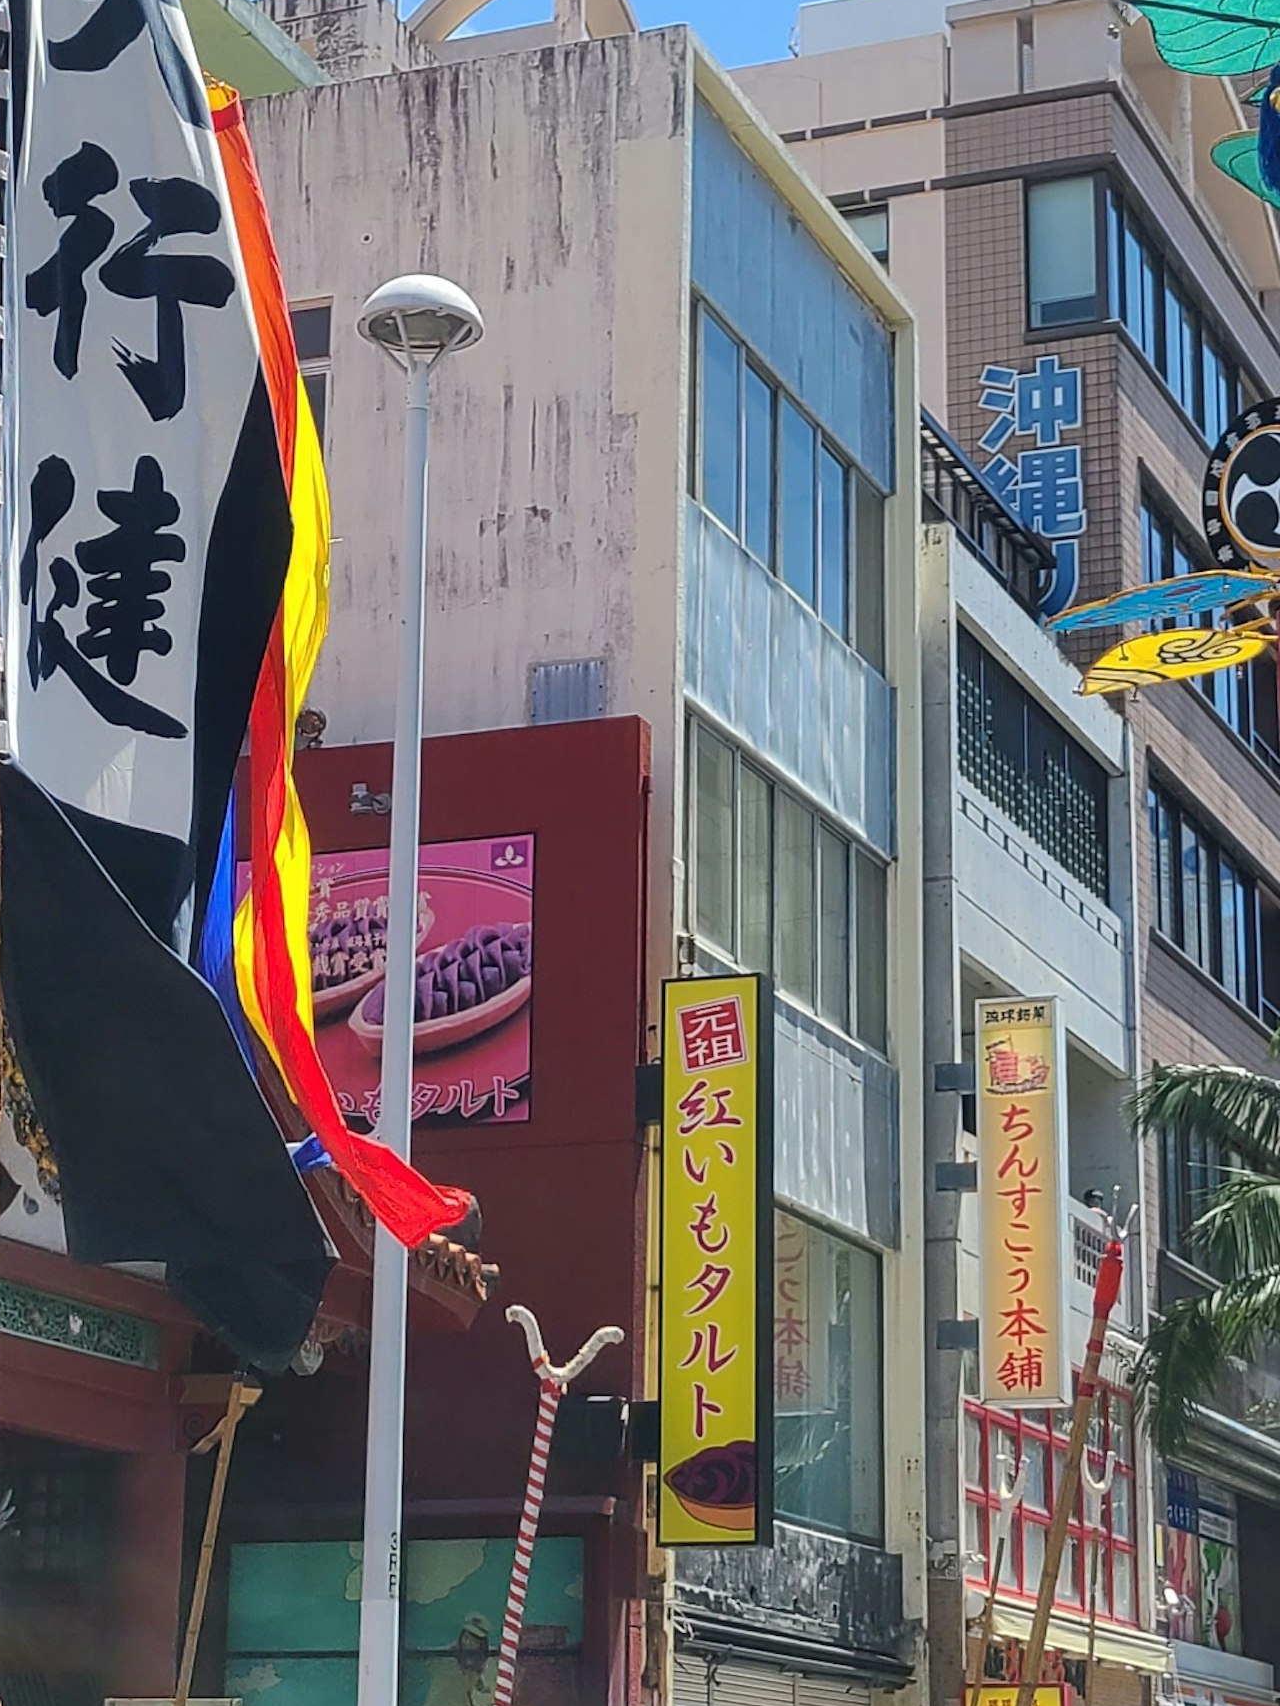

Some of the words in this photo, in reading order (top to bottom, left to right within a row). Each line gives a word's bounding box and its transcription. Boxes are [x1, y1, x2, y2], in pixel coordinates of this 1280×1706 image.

[686, 1004, 742, 1068] 元祖
[677, 1080, 743, 1438] 紅いもタルト
[997, 1104, 1048, 1393] ちんすこう本舗
